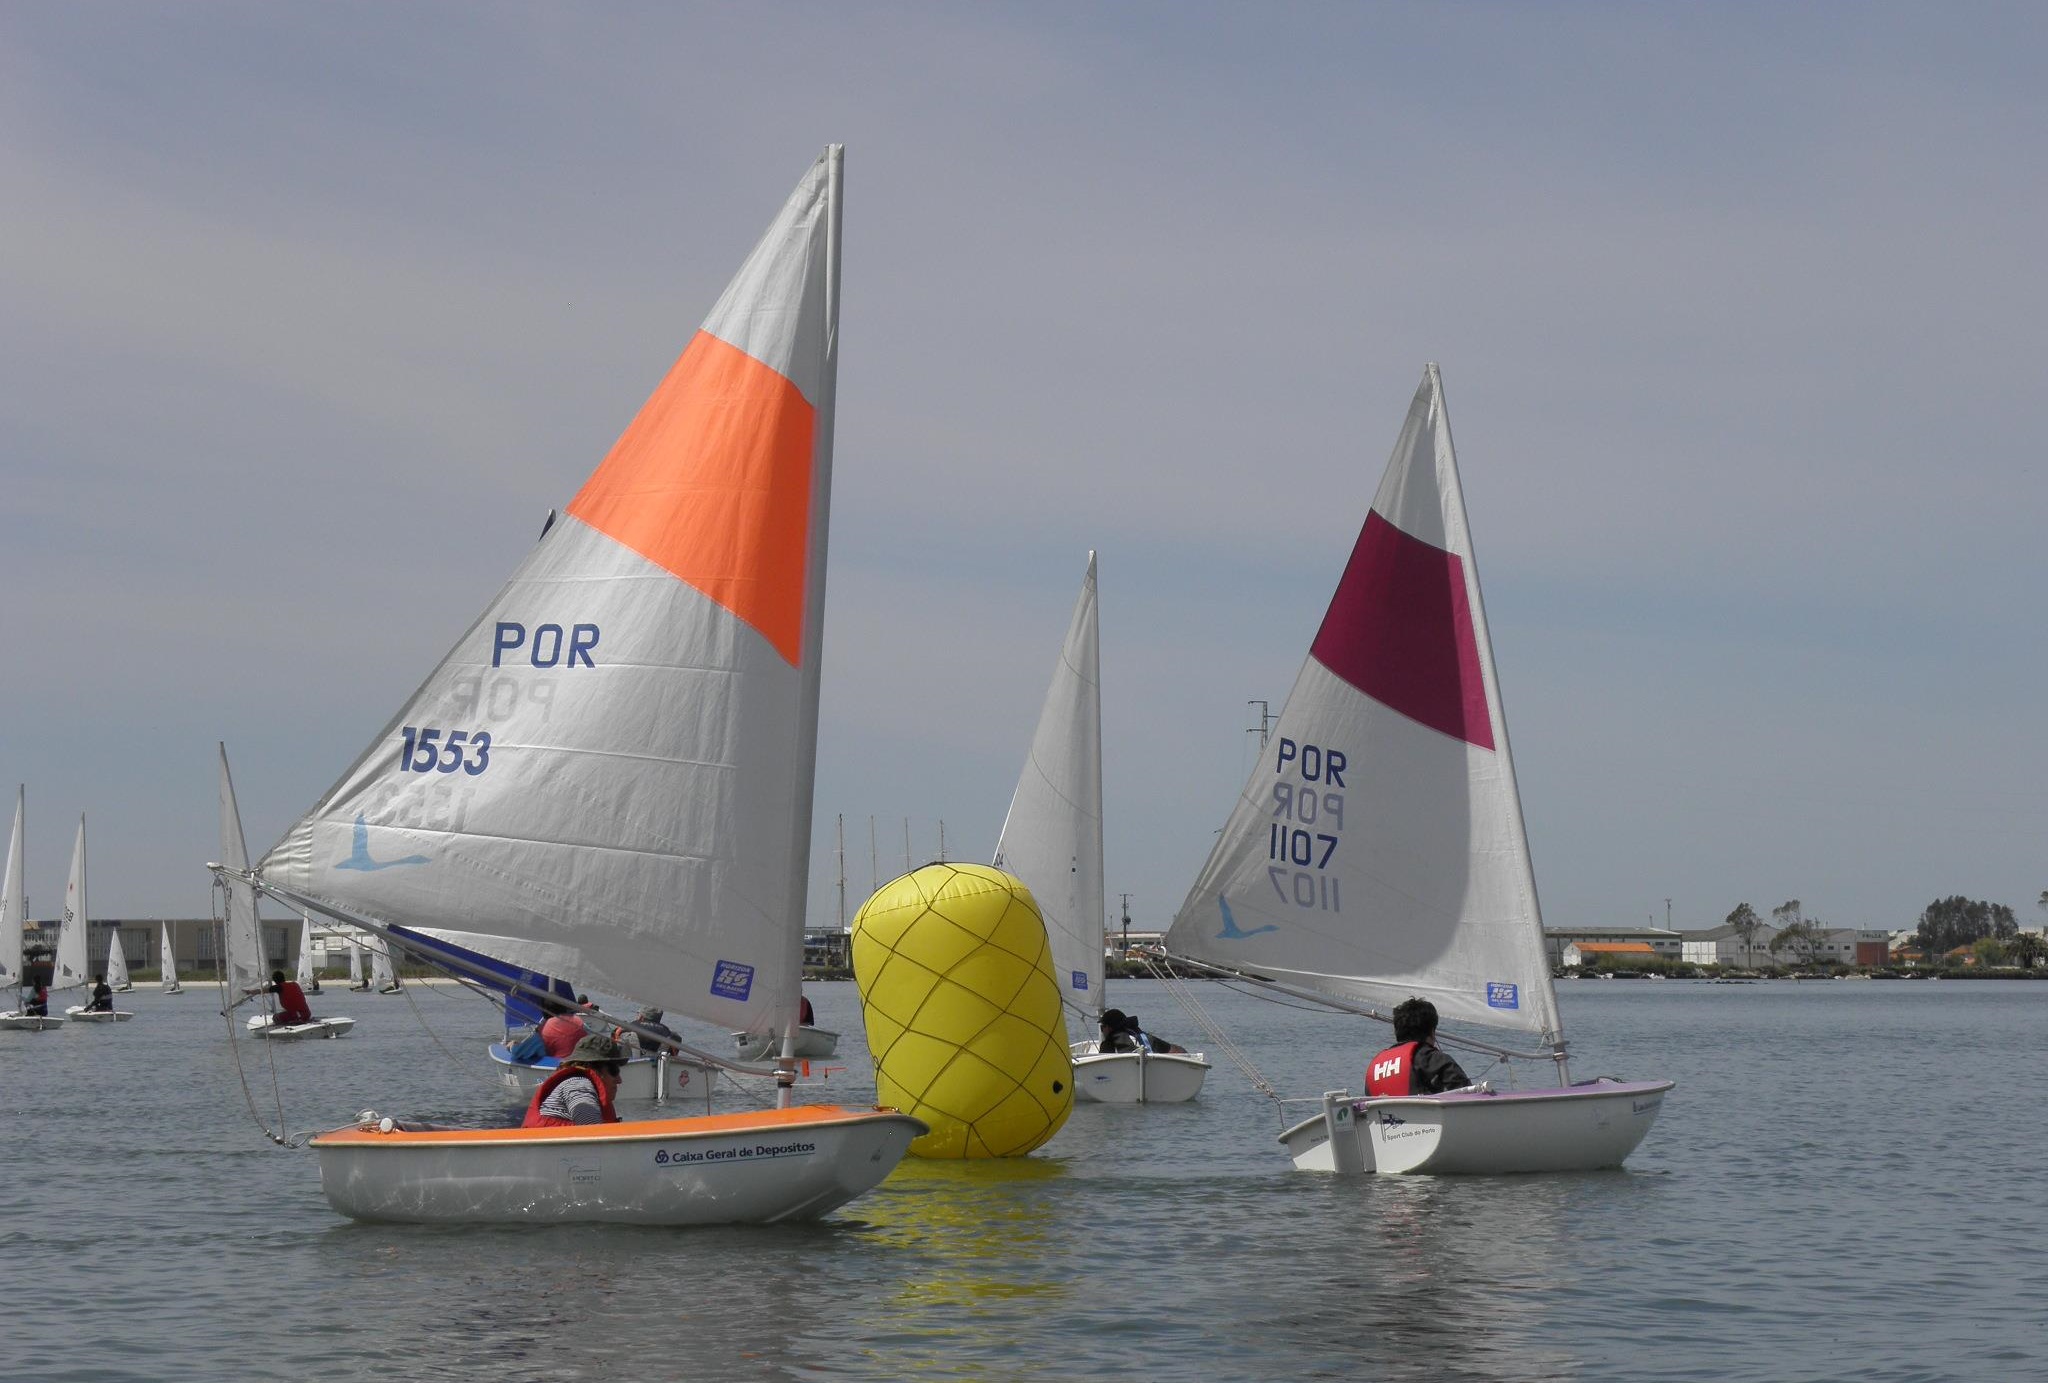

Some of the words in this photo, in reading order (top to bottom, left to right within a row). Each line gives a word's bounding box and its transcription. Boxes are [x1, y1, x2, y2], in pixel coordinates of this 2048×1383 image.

[492, 621, 600, 669] POR
[400, 726, 492, 776] 1553
[1276, 737, 1347, 789] POR
[1269, 822, 1339, 870] 1107
[1374, 1056, 1401, 1081] HH
[672, 1151, 704, 1163] Caixa
[706, 1148, 737, 1160] Geral
[739, 1146, 753, 1157] de
[756, 1142, 816, 1157] Depositos
[1401, 1130, 1414, 1138] Club
